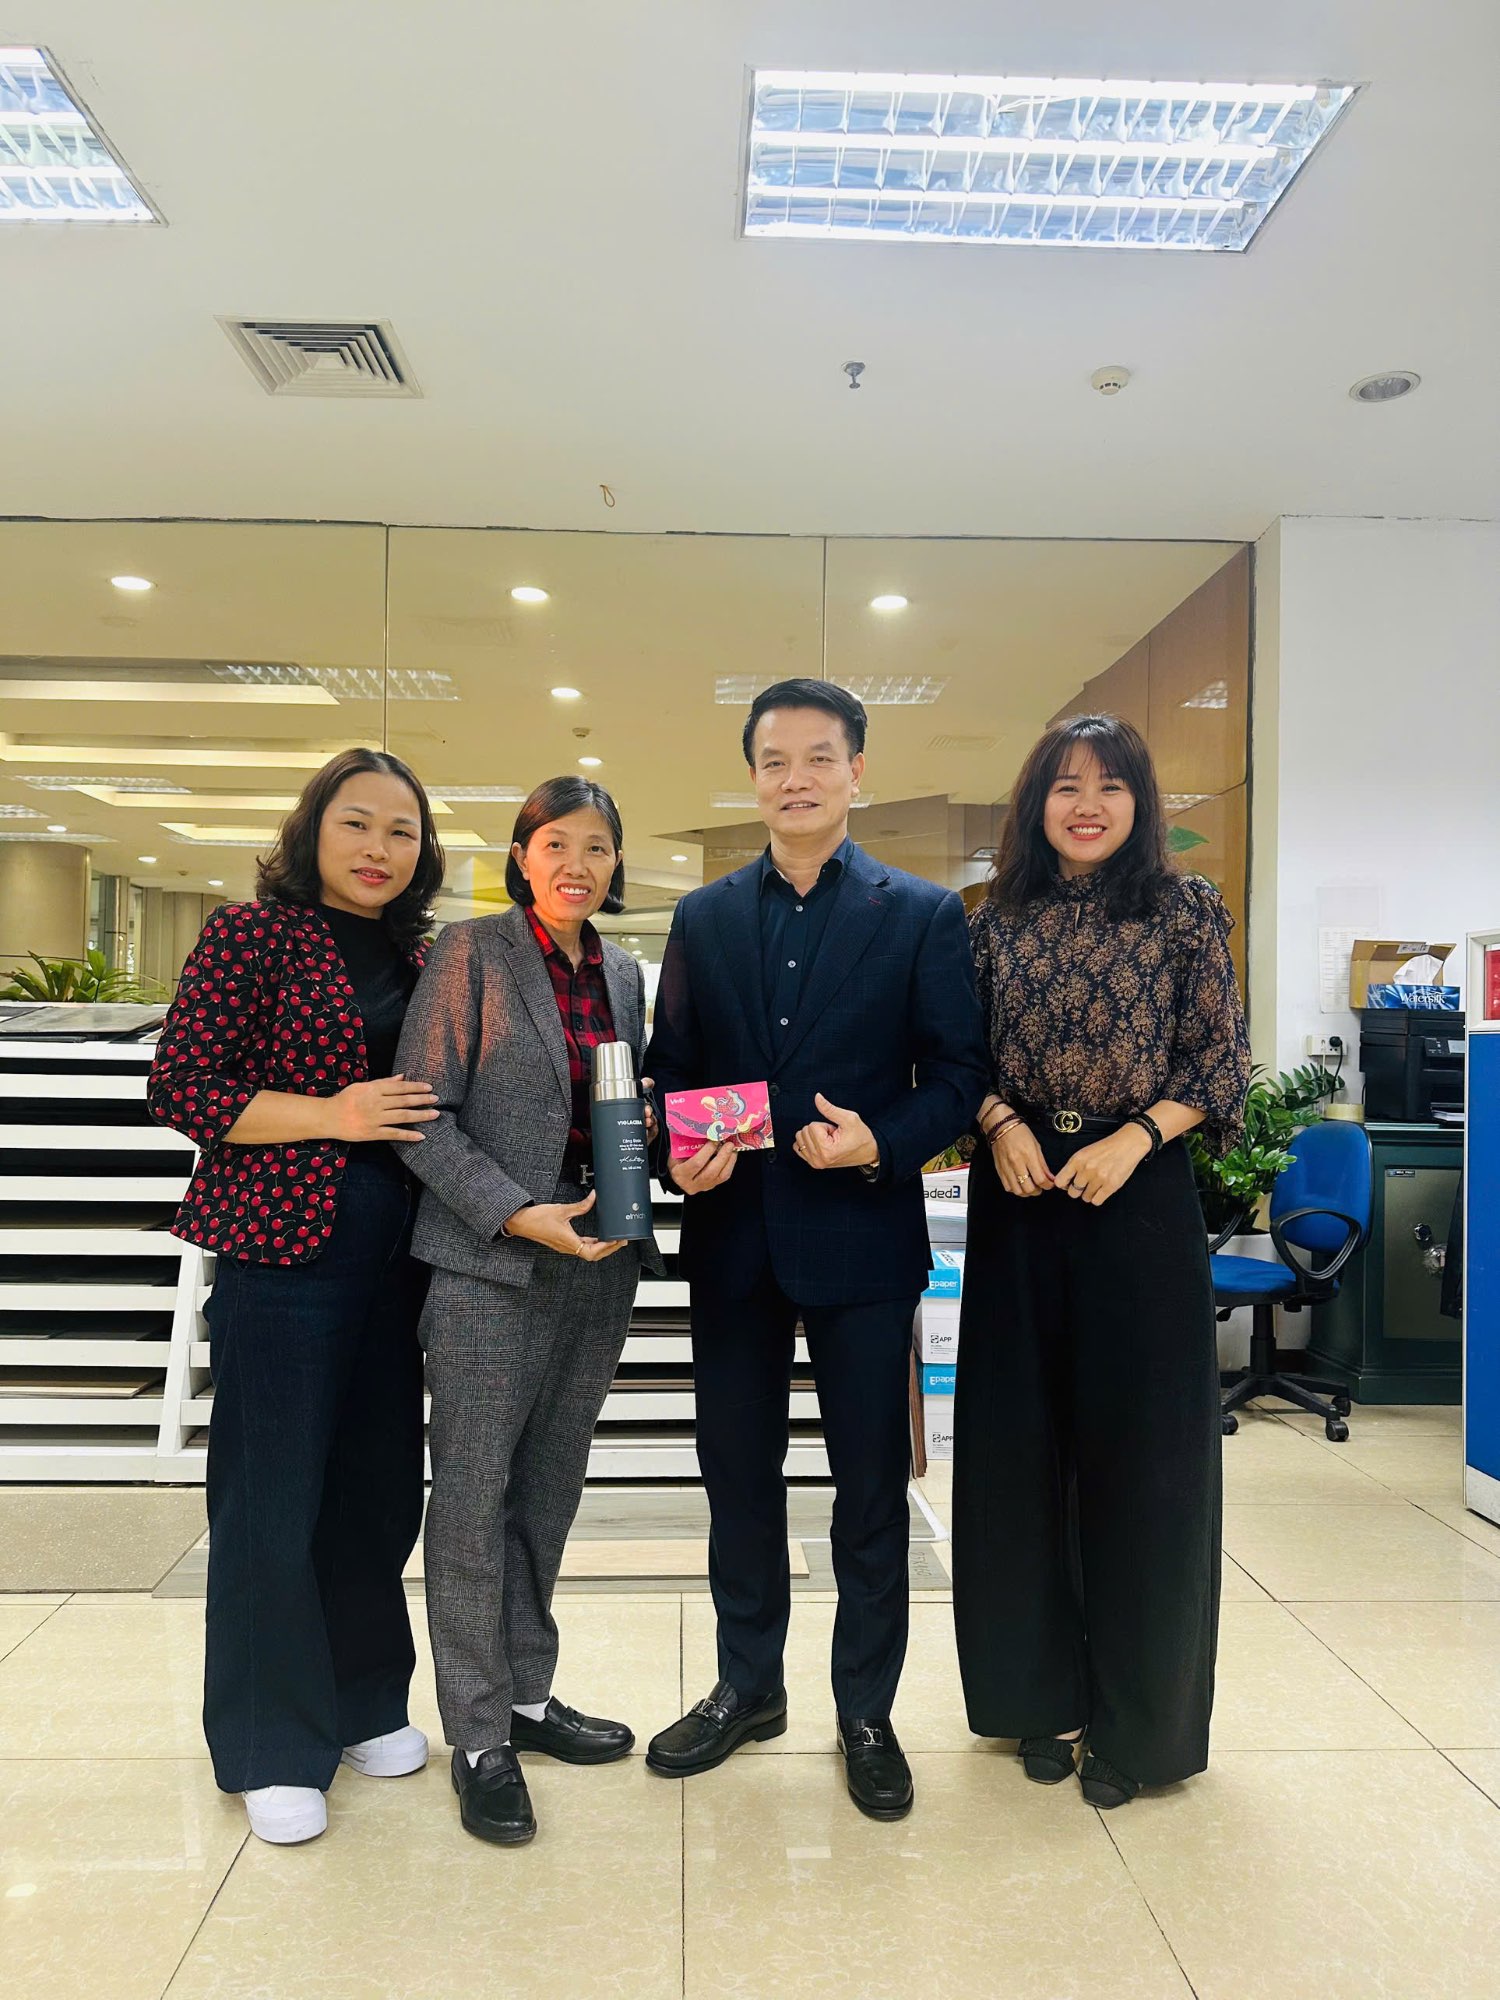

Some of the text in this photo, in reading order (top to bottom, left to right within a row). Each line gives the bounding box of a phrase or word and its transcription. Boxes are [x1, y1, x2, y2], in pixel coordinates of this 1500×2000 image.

[923, 1186, 960, 1198] Epape
[929, 1281, 958, 1289] Epaper
[930, 1376, 956, 1385] Epape
